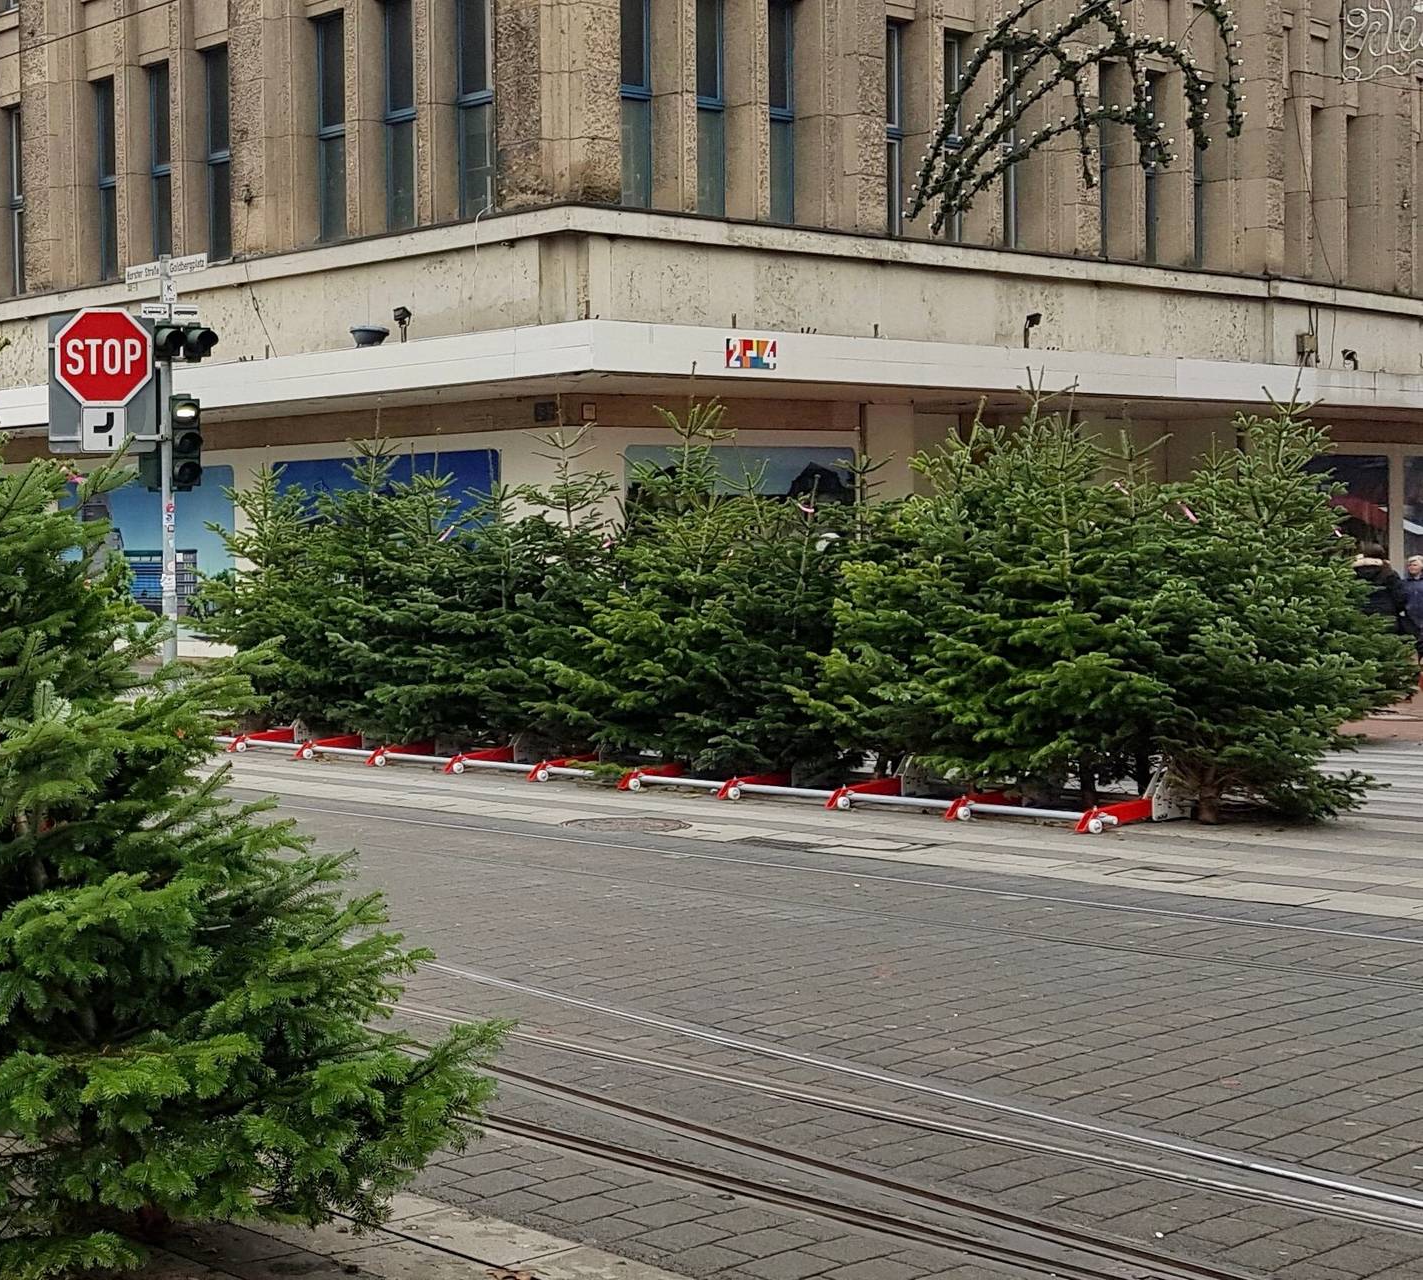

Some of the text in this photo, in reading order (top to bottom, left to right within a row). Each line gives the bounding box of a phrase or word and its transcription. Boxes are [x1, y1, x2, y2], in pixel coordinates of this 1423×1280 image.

[145, 265, 160, 277] Straße
[169, 258, 205, 273] Goldbergplatz
[66, 338, 142, 376] STOP
